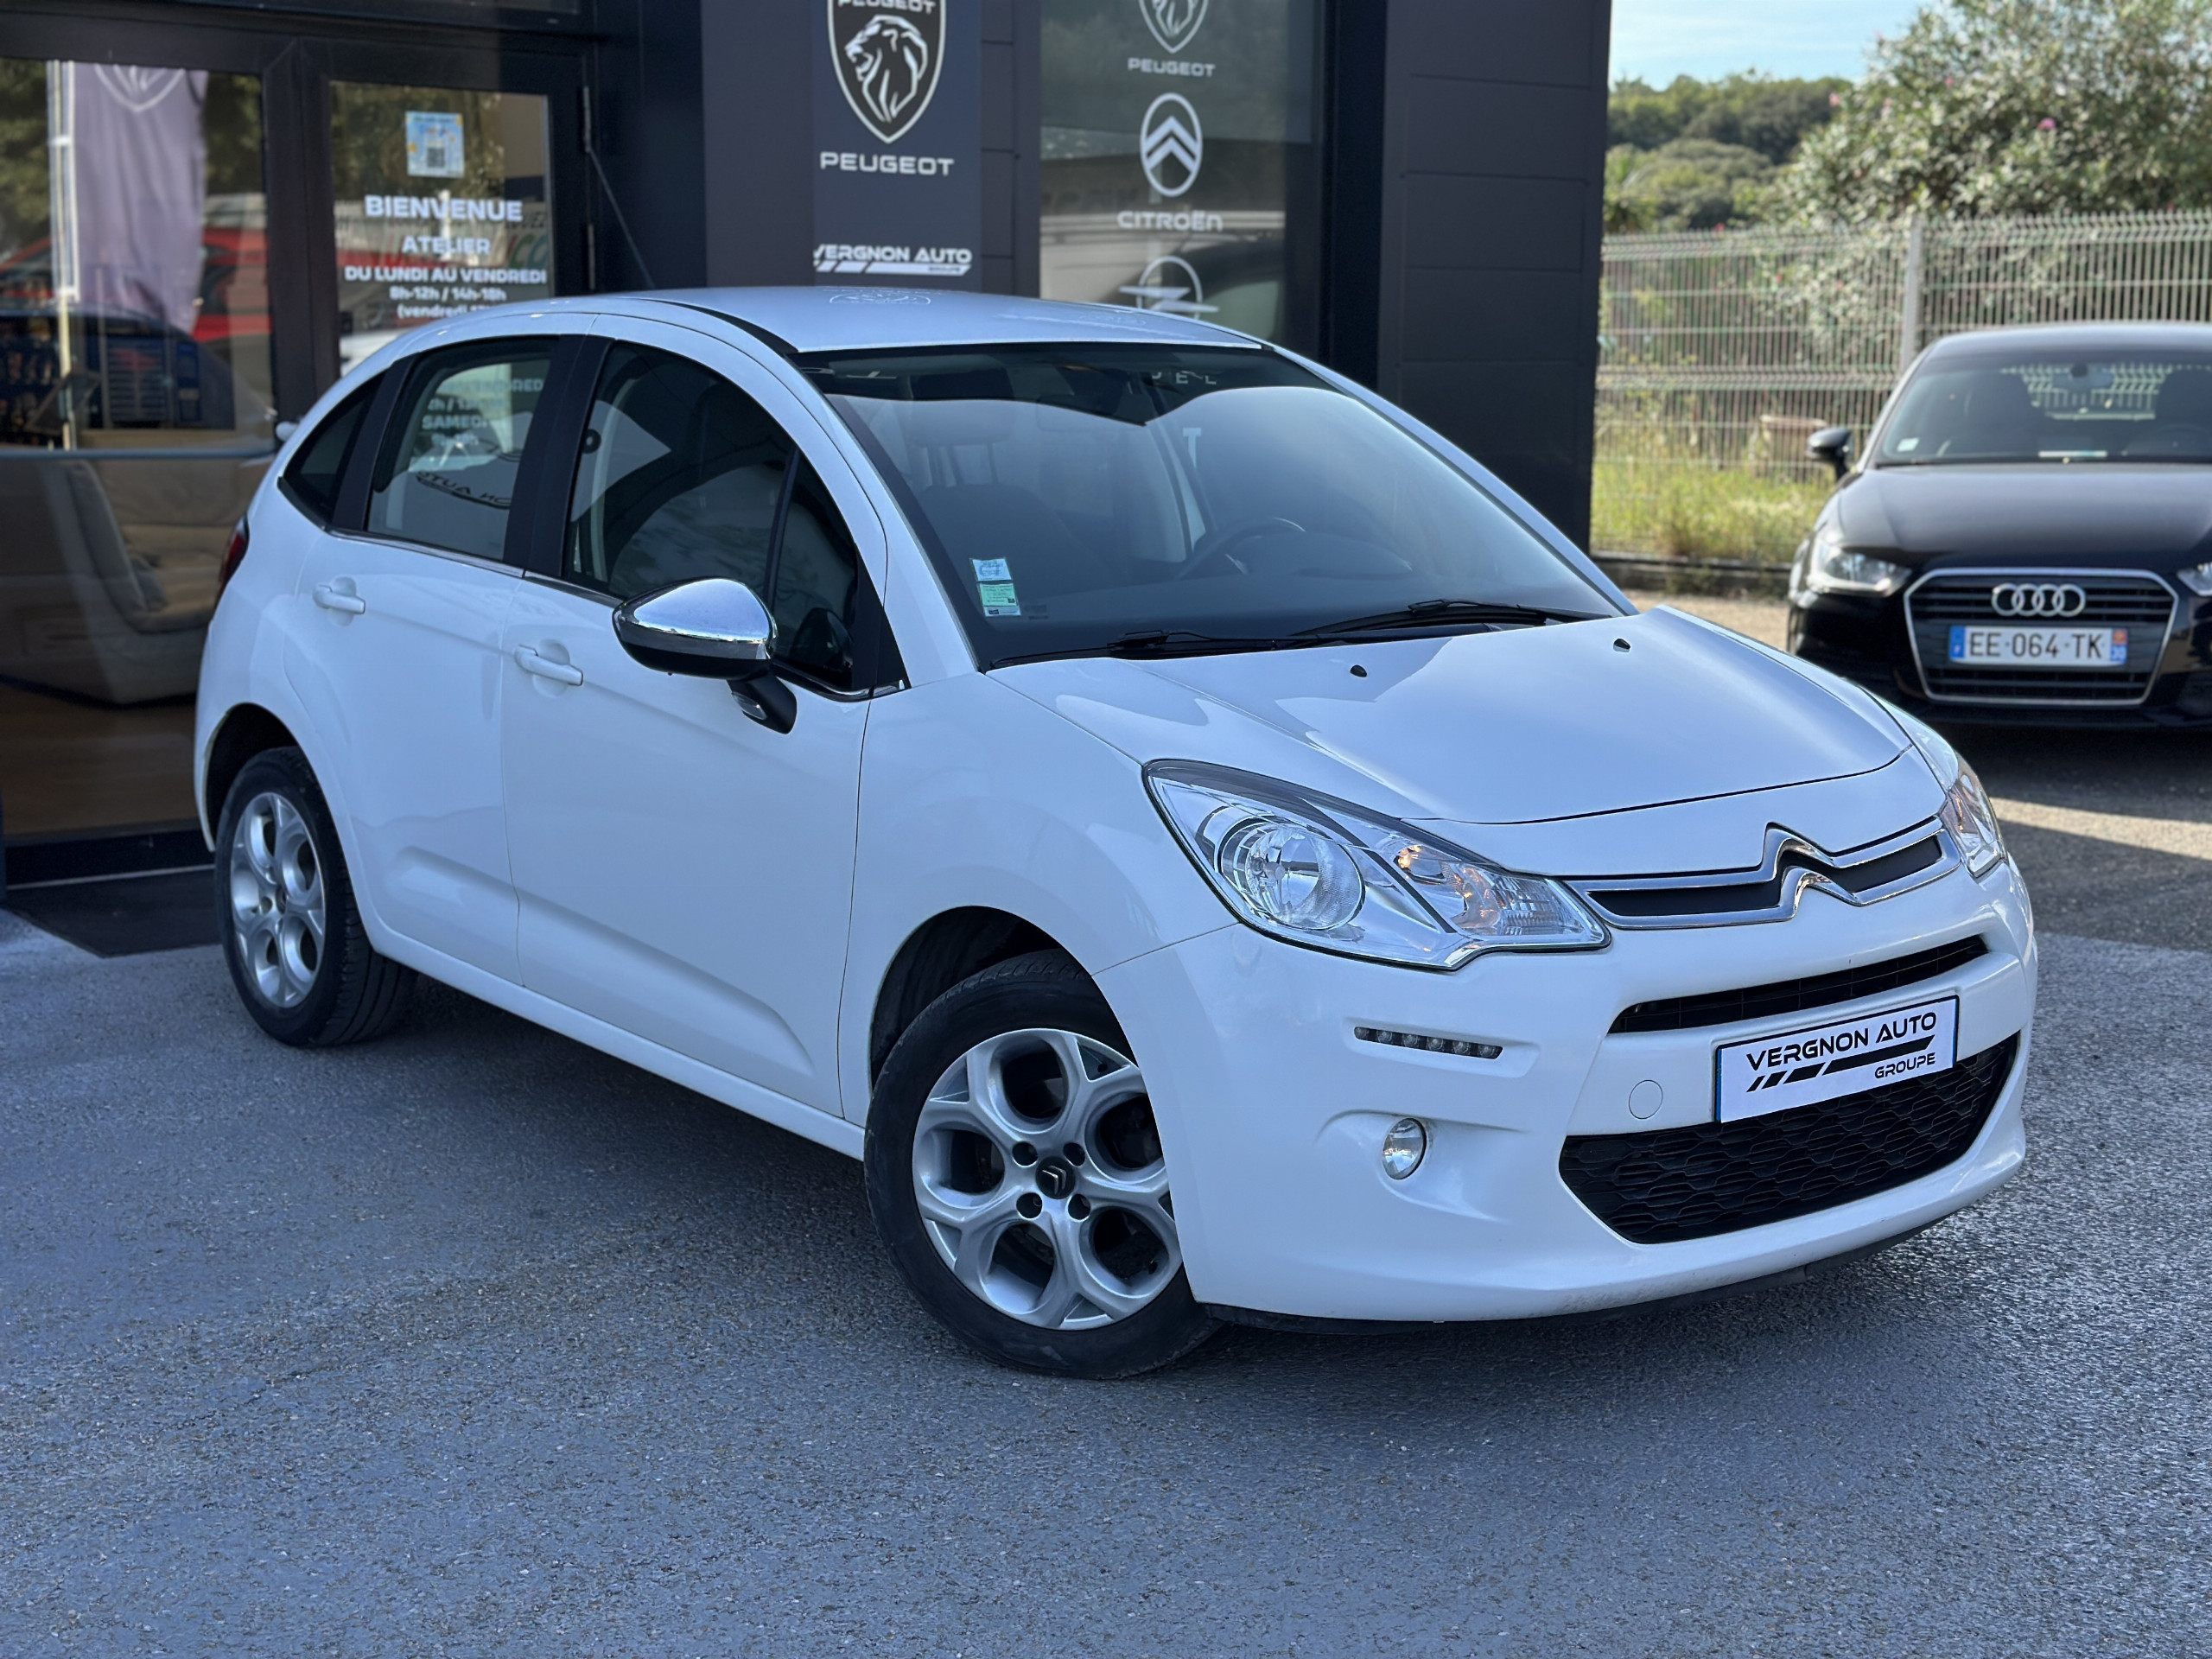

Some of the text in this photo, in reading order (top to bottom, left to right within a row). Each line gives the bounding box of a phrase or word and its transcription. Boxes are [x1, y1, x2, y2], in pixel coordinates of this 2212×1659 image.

[1128, 58, 1216, 77] PEUGEOT
[820, 151, 954, 175] PEUGEOT
[365, 195, 523, 222] BIENVENUE
[402, 236, 491, 255] ATELIER
[914, 246, 972, 264] AUTO
[346, 266, 547, 284] DU LUNDI AU VENDREDI
[1746, 1012, 1936, 1071] VERGNON AUTO
[1874, 1052, 1936, 1079] GROUPE
